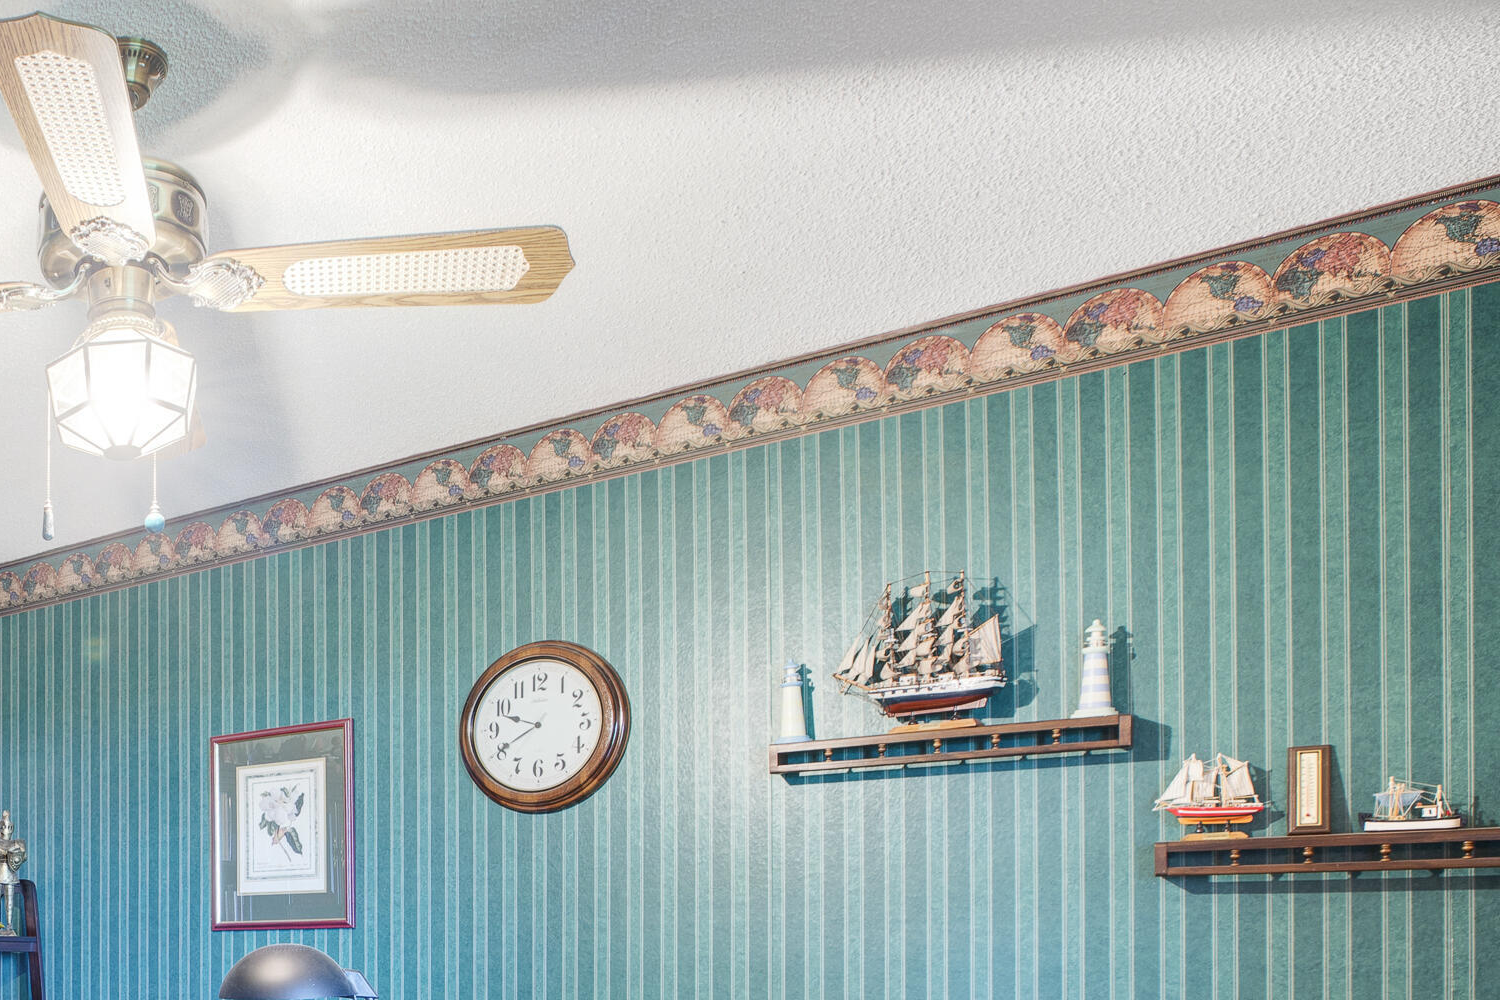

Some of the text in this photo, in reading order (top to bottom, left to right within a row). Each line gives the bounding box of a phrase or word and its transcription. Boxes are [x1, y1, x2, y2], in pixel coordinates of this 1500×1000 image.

[514, 681, 524, 699] 11
[532, 672, 548, 692] 12
[560, 675, 565, 694] 1
[496, 698, 511, 717] 10
[572, 689, 583, 708] 2
[489, 721, 500, 740] 9
[496, 742, 508, 761] 8
[572, 735, 585, 754] 4
[513, 757, 523, 775] 7
[532, 759, 544, 778] 6
[554, 753, 566, 771] 5
